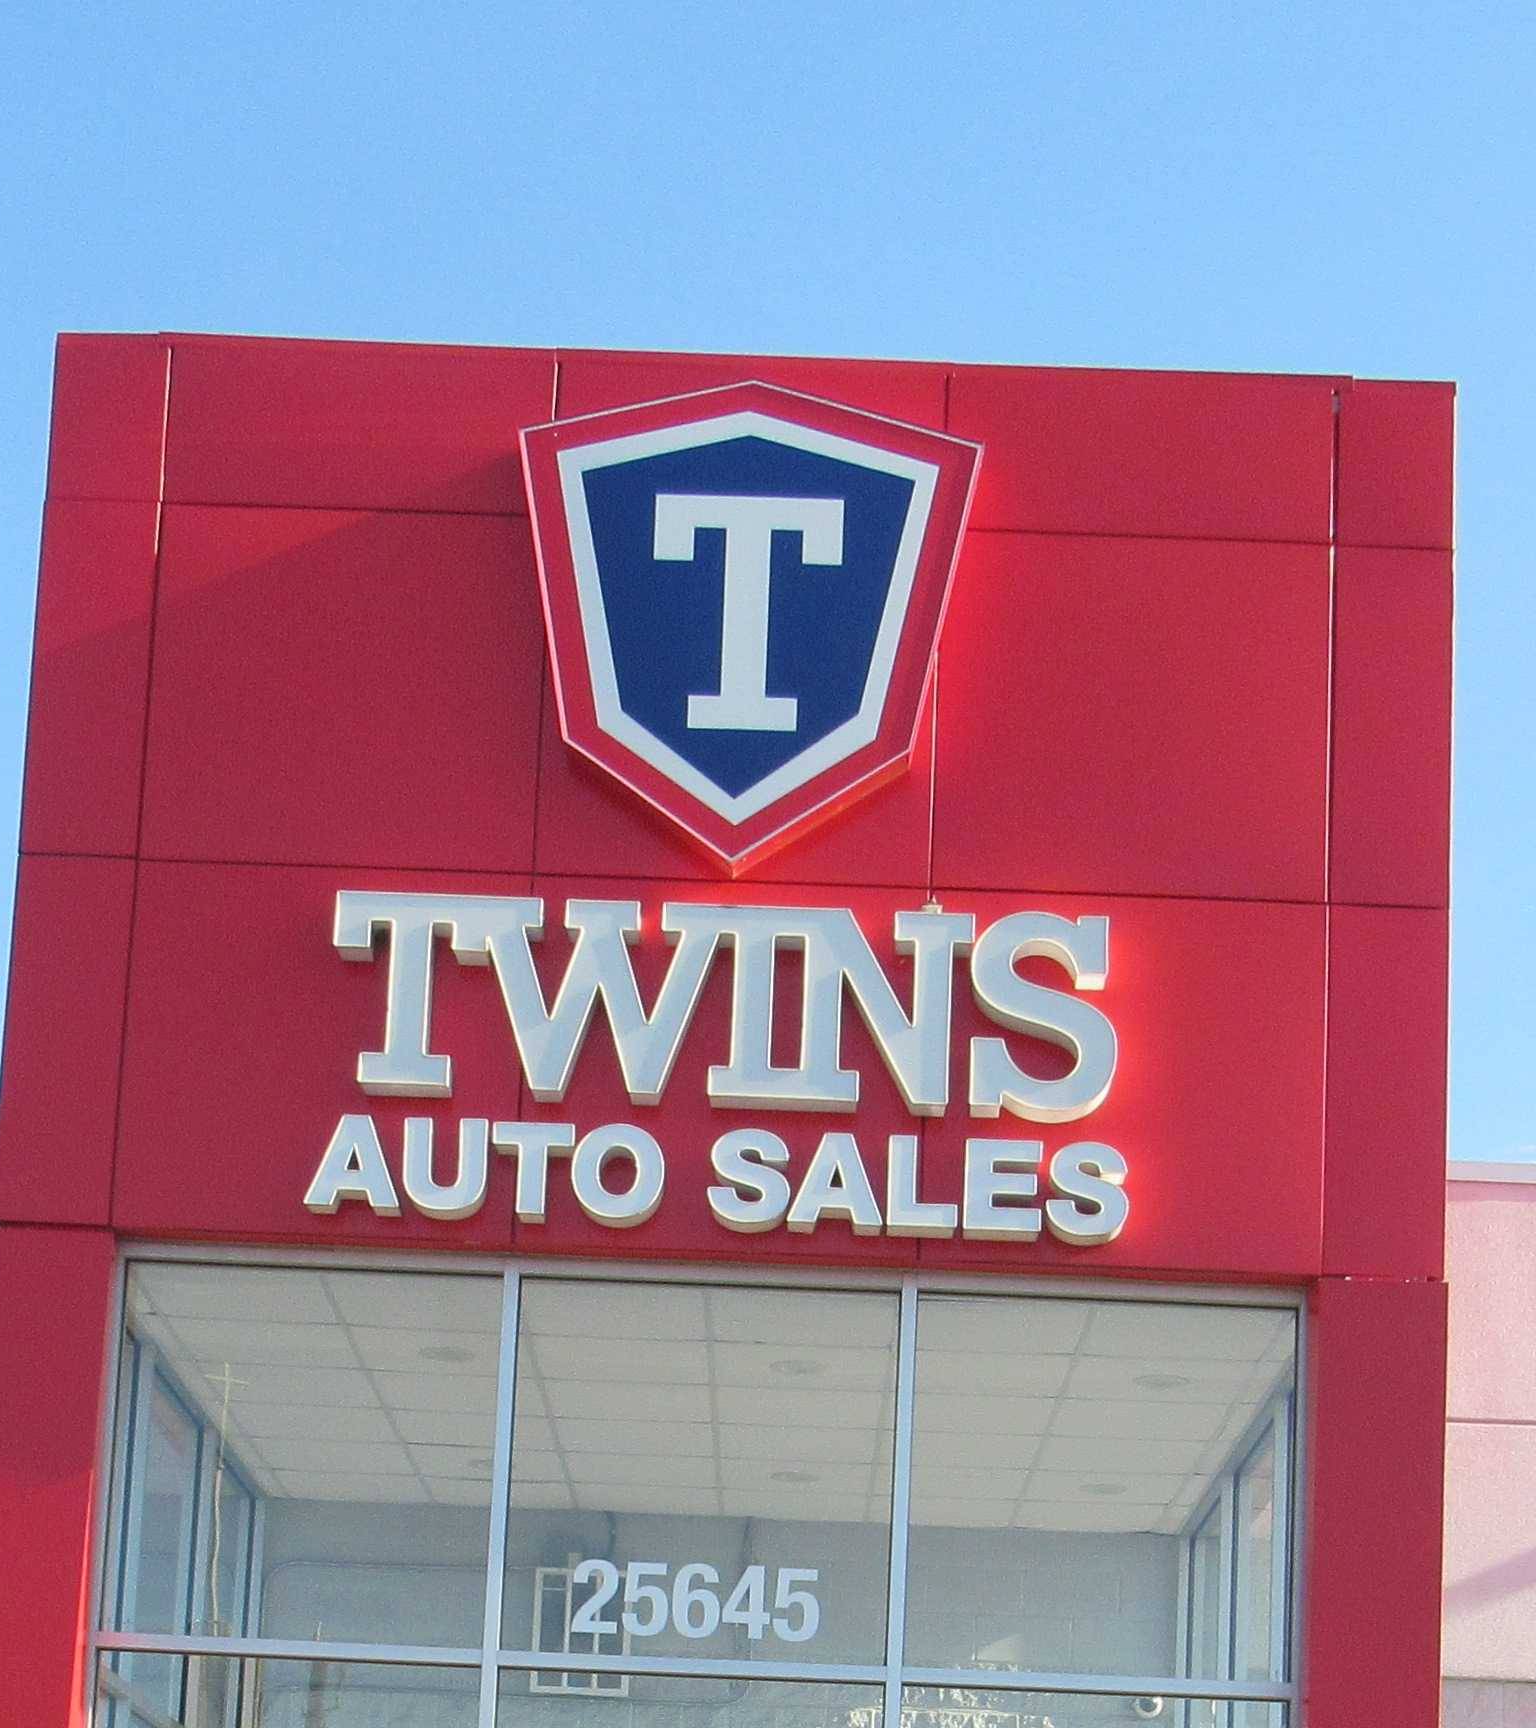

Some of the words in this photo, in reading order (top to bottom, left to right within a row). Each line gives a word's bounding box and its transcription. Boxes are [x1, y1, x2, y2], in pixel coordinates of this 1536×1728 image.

[654, 493, 845, 733] T
[332, 889, 1119, 1126] TWINS
[303, 1113, 667, 1231] AUTO
[705, 1126, 1130, 1247] SALES
[570, 1558, 821, 1642] 25645
